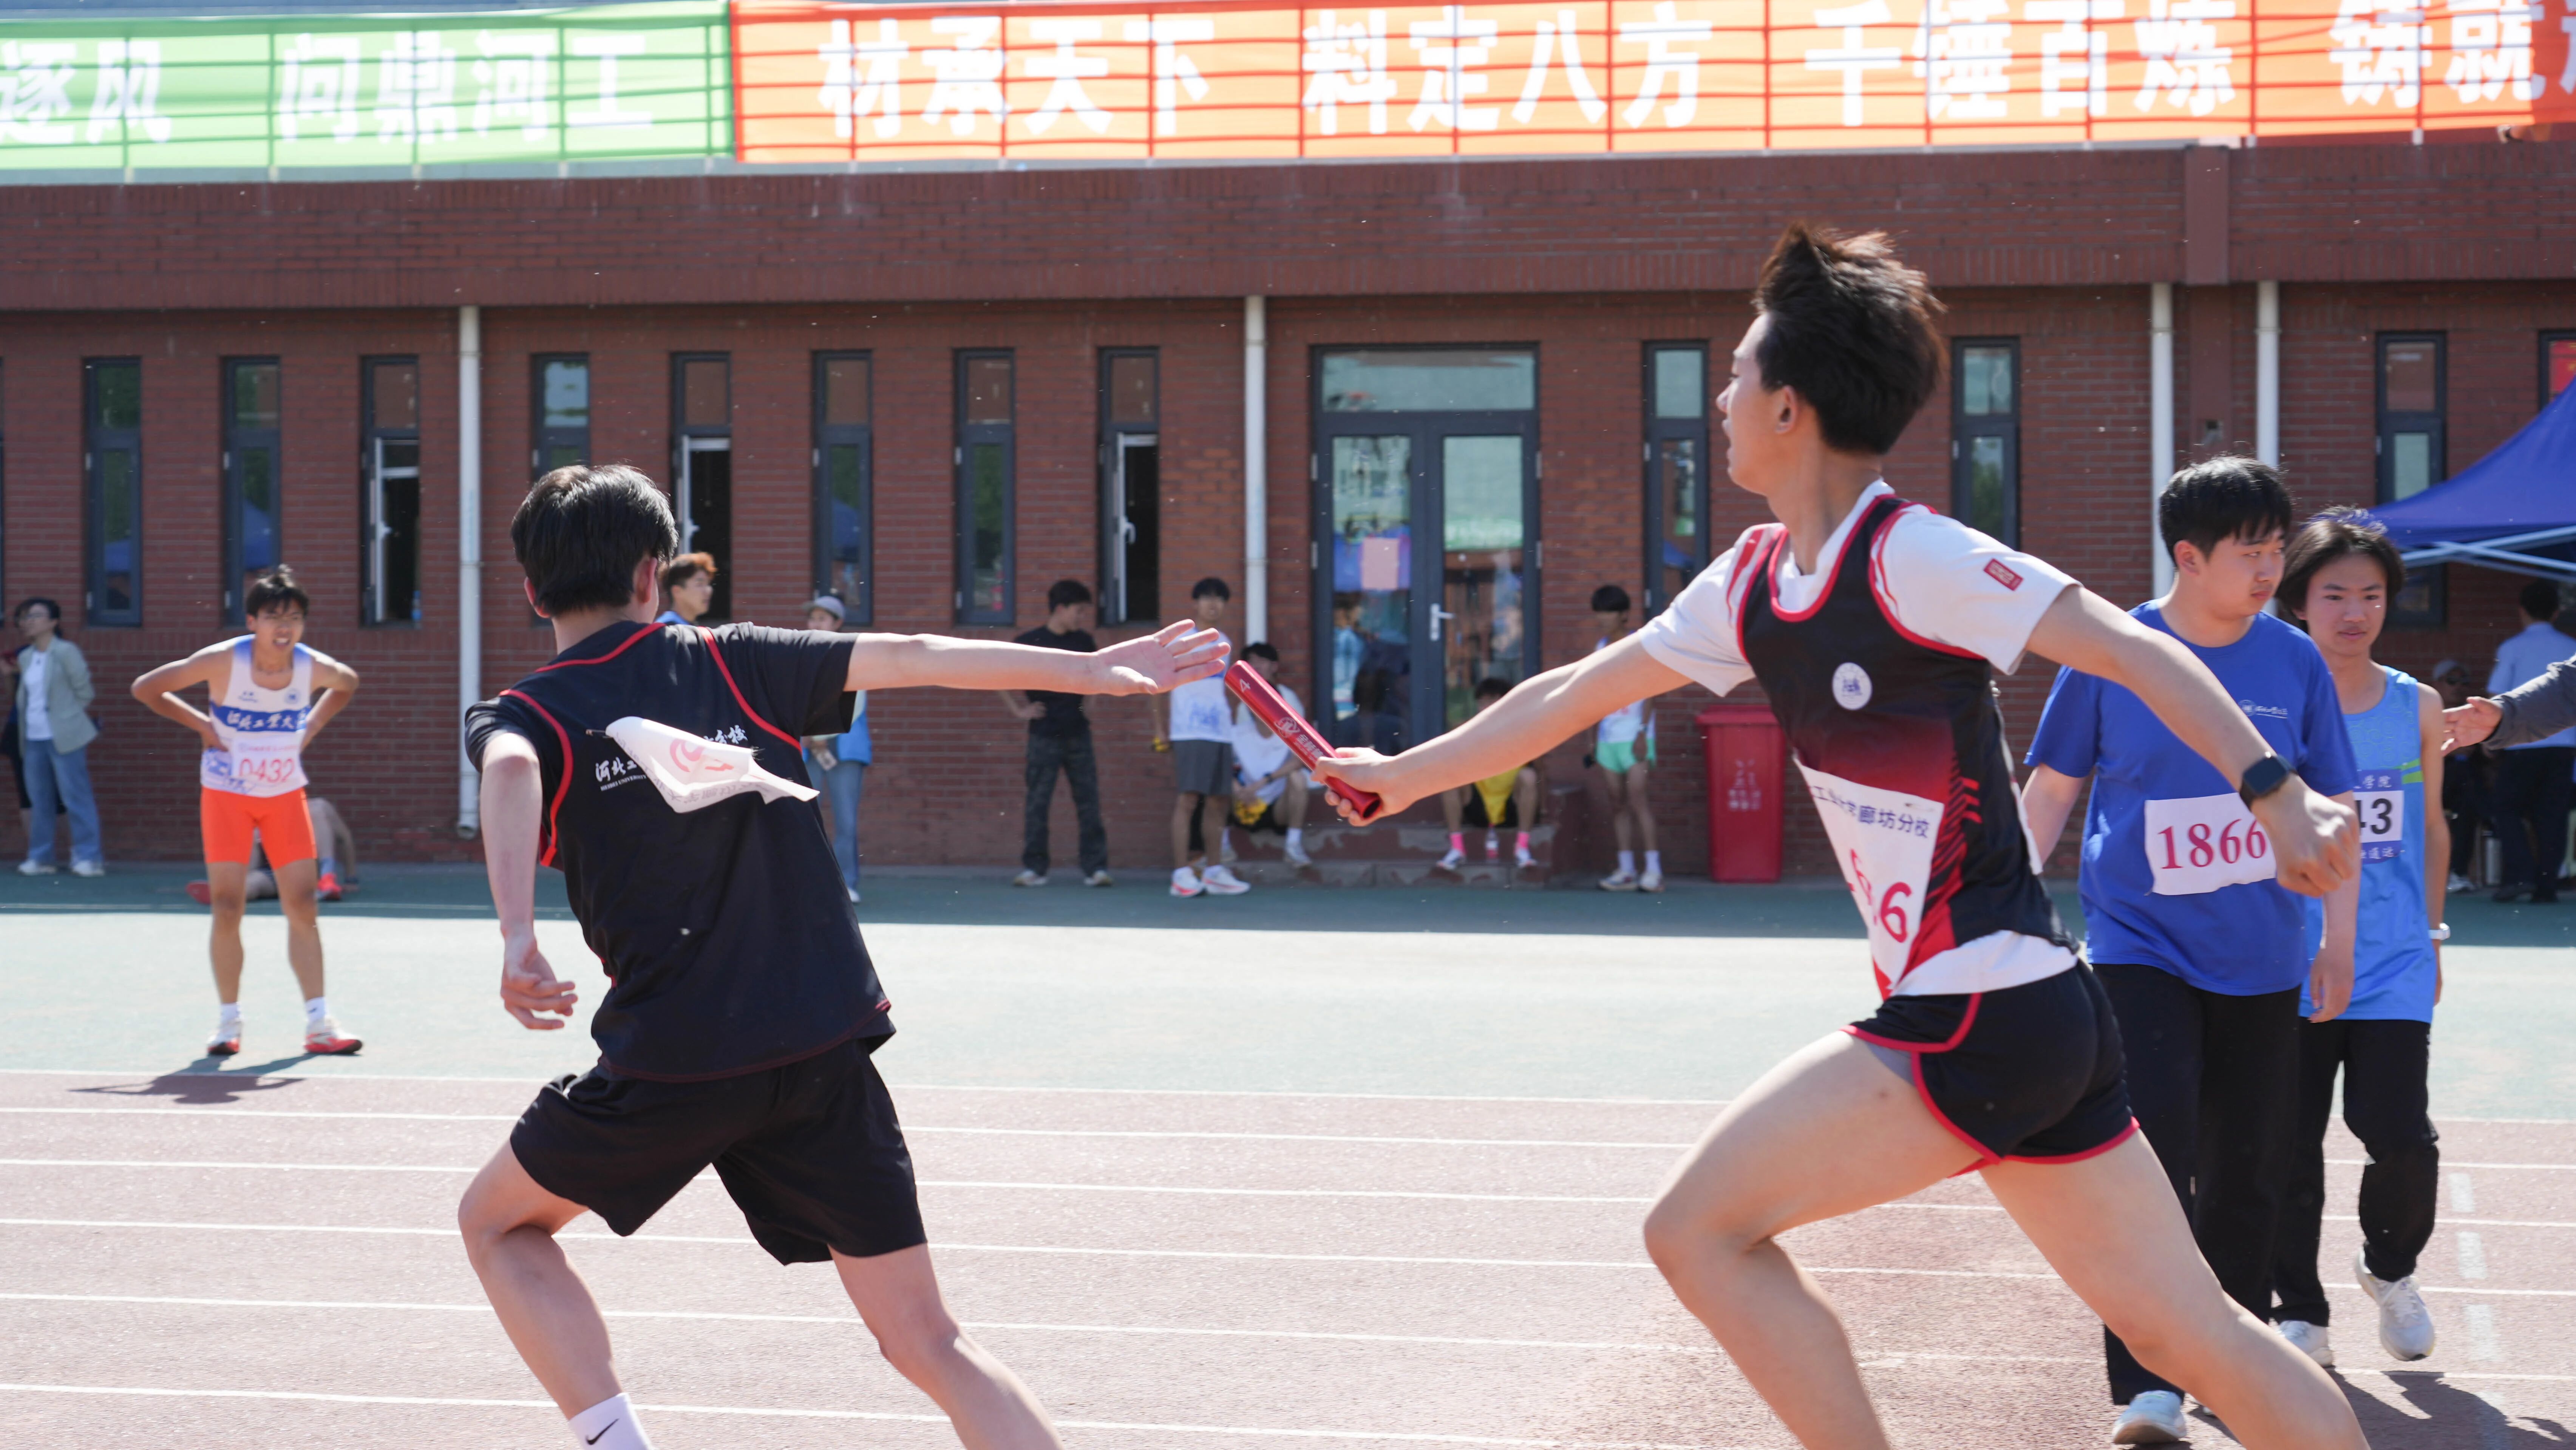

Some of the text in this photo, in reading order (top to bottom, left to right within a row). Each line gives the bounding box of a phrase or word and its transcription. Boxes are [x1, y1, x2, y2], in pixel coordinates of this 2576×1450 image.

[0, 29, 653, 144] 逐风 问鼎河工
[816, 16, 1214, 138] 材承天下
[1301, 5, 1713, 135] 料定八方
[1805, 0, 2236, 126] 千锤百炼
[1239, 679, 1251, 693] 4
[239, 758, 294, 783] 0432
[2353, 774, 2392, 789] 学院
[2157, 818, 2266, 869] 1866
